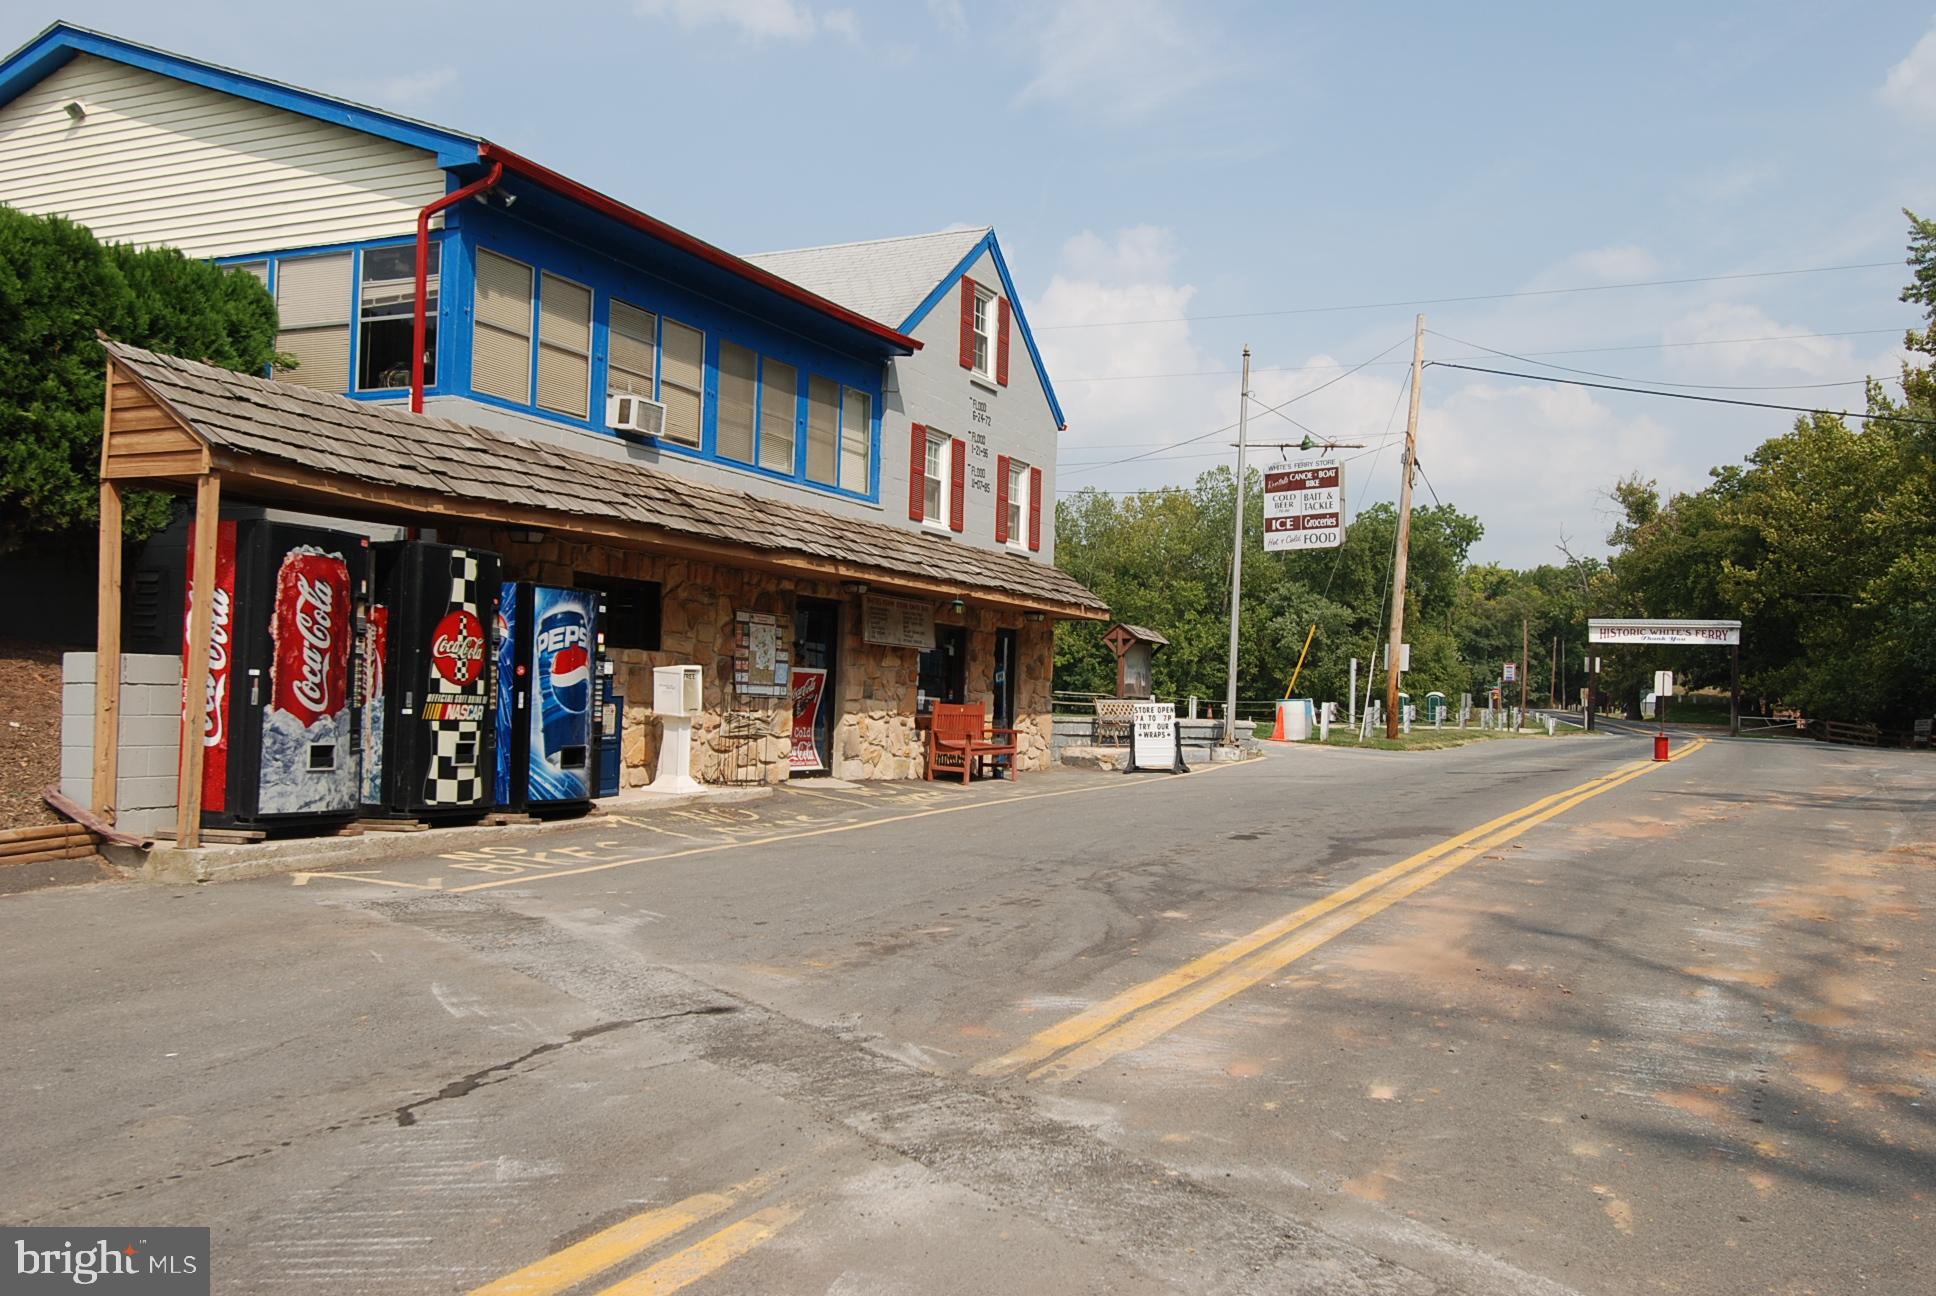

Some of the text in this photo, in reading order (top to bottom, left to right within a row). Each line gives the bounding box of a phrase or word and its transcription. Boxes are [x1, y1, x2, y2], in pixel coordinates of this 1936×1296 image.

[972, 399, 987, 412] FLOOD
[972, 410, 992, 426] 6-24-72
[971, 431, 986, 446] FLOOD
[1294, 461, 1313, 469] FERRY
[971, 466, 986, 479] FLOOD
[1290, 472, 1313, 480] CANOE
[1318, 469, 1336, 477] BOAT
[1305, 479, 1320, 487] BIKE
[1272, 493, 1297, 502] COLD
[1304, 491, 1333, 502] BAIT &
[1274, 501, 1294, 509] BEER
[1304, 501, 1334, 511] TACKLE
[1271, 518, 1294, 530] ICE
[1304, 515, 1337, 528] Groceries
[1285, 534, 1302, 544] Cold
[1303, 533, 1337, 544] FOOD
[1599, 628, 1729, 641] HISTORIC WHITE'S FERRY
[426, 693, 454, 703] OFFICIAL
[454, 694, 468, 703] SOFT
[467, 695, 482, 704] DRINK
[445, 703, 484, 721] NASCAR
[794, 726, 811, 738] Cold
[438, 846, 528, 861] NO
